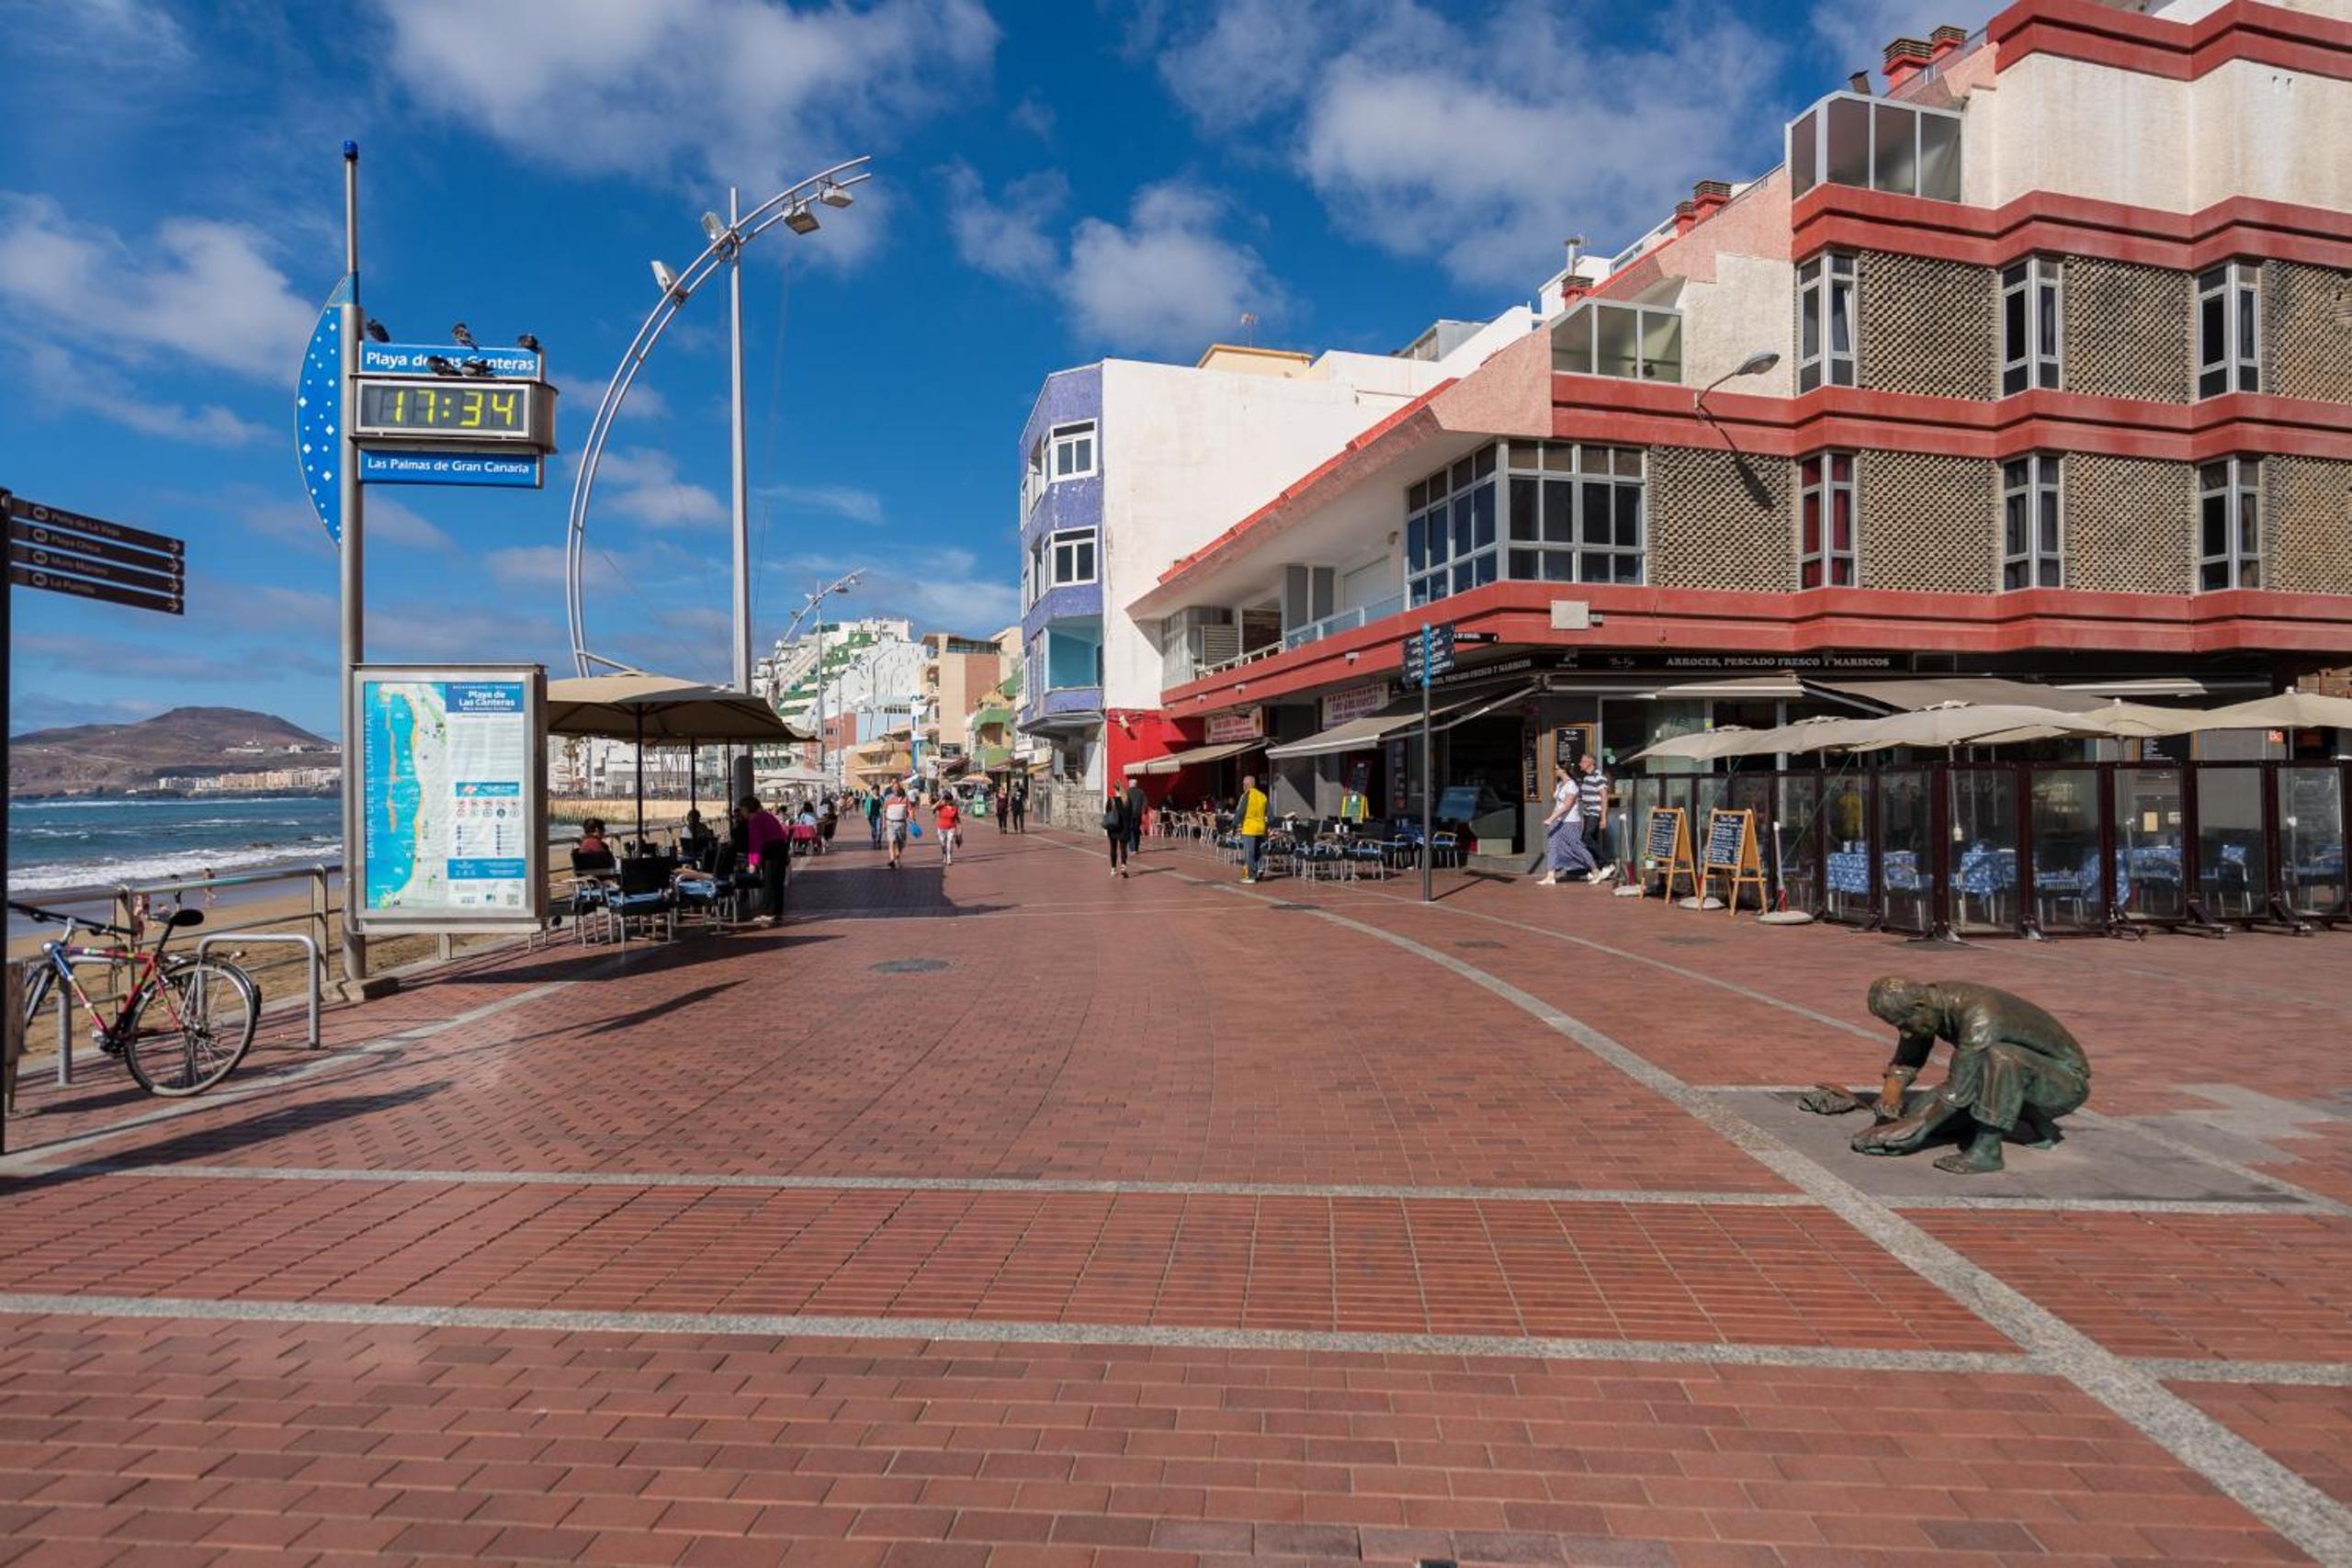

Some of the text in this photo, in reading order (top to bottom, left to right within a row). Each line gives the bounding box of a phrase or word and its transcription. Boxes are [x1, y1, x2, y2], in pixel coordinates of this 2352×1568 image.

[366, 352, 407, 369] Playa
[467, 355, 535, 371] Cnteras
[392, 389, 515, 427] 17:34
[368, 457, 529, 475] Las Palmas de Gran Canaria
[1666, 658, 1722, 668] ARROCES,
[1724, 658, 1776, 667] PESCADO
[1778, 658, 1820, 667] FRESCO
[1833, 658, 1890, 668] MARISCOS
[458, 698, 515, 706] Las Canteras
[469, 690, 506, 700] Playa de
